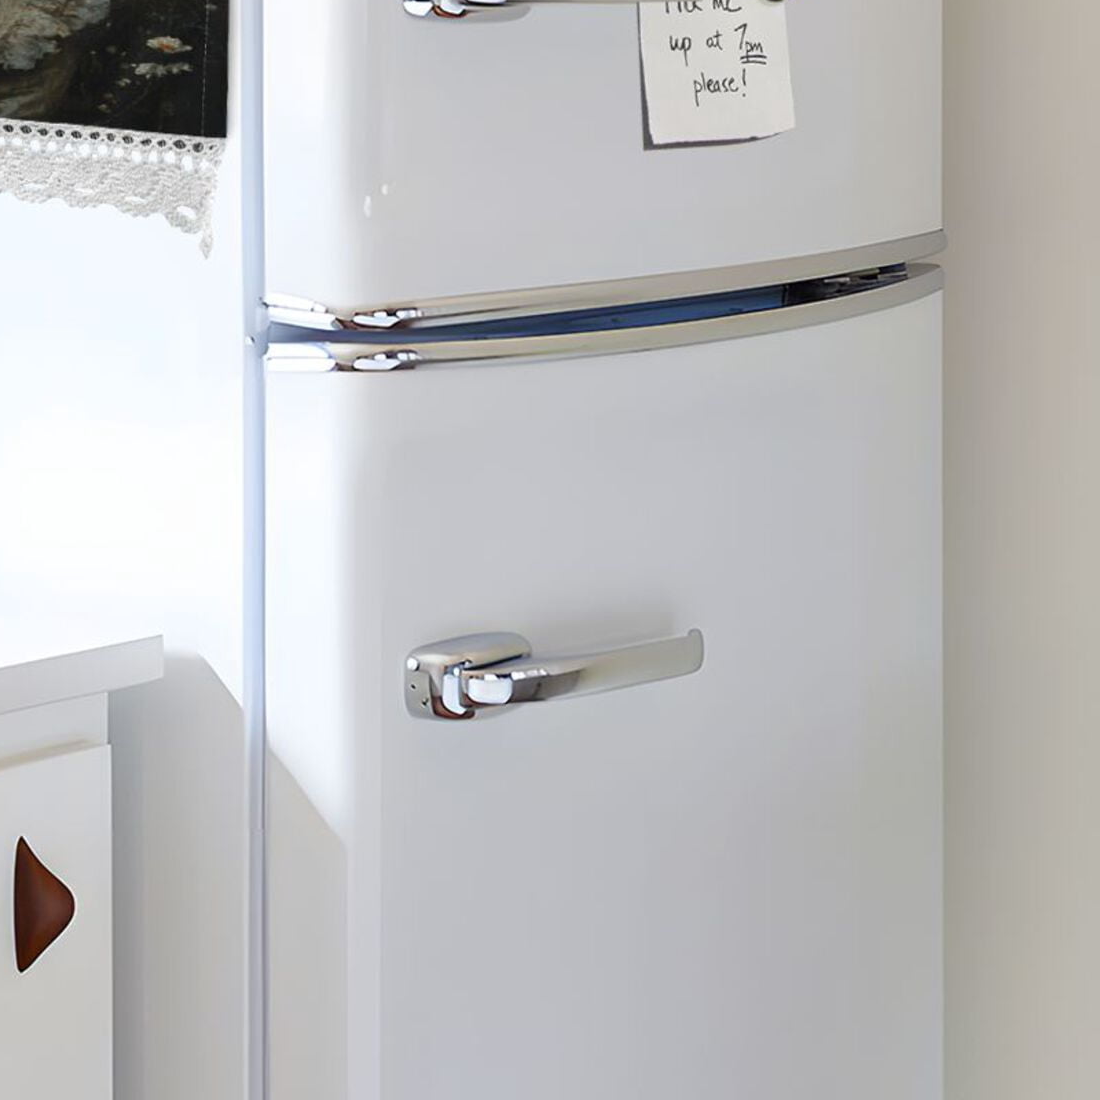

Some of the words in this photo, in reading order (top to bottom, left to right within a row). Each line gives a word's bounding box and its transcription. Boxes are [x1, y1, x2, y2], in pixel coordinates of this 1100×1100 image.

[669, 35, 692, 66] up
[706, 30, 723, 51] at
[693, 68, 747, 107] please!
